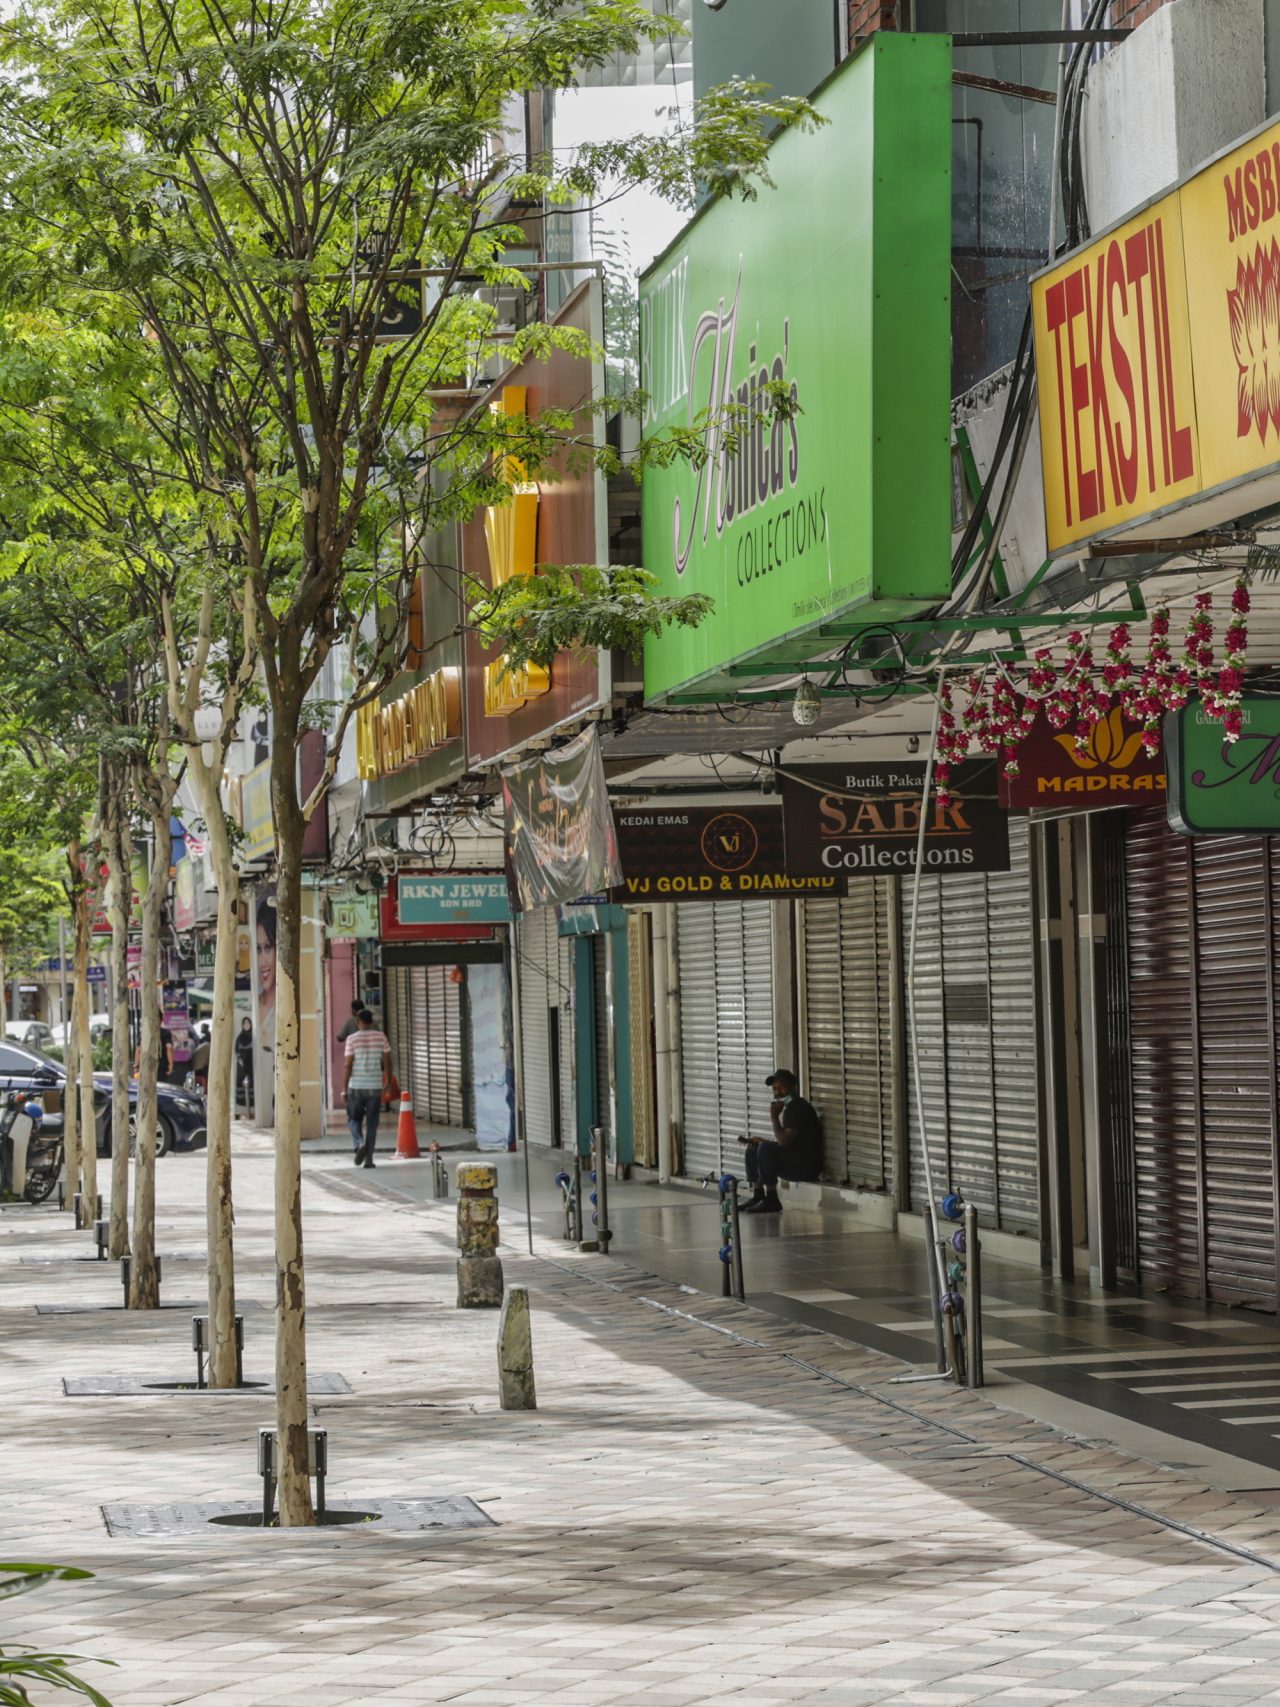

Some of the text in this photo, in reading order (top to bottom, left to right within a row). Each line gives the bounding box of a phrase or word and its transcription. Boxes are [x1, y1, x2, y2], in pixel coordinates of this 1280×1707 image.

[642, 255, 688, 430] BUTIK
[1045, 217, 1193, 527] TEKSTIL
[674, 252, 799, 577] Monica's
[737, 486, 826, 587] COLLECTIONS
[846, 774, 938, 788] Butik Pakai
[1037, 774, 1168, 793] MADRAS
[620, 815, 689, 826] KEDAI EMAS
[821, 844, 974, 869] Collectons
[402, 885, 445, 899] RKN
[627, 874, 835, 893] VJ GOLD & DIAMOND
[440, 899, 482, 908] SDN BHD
